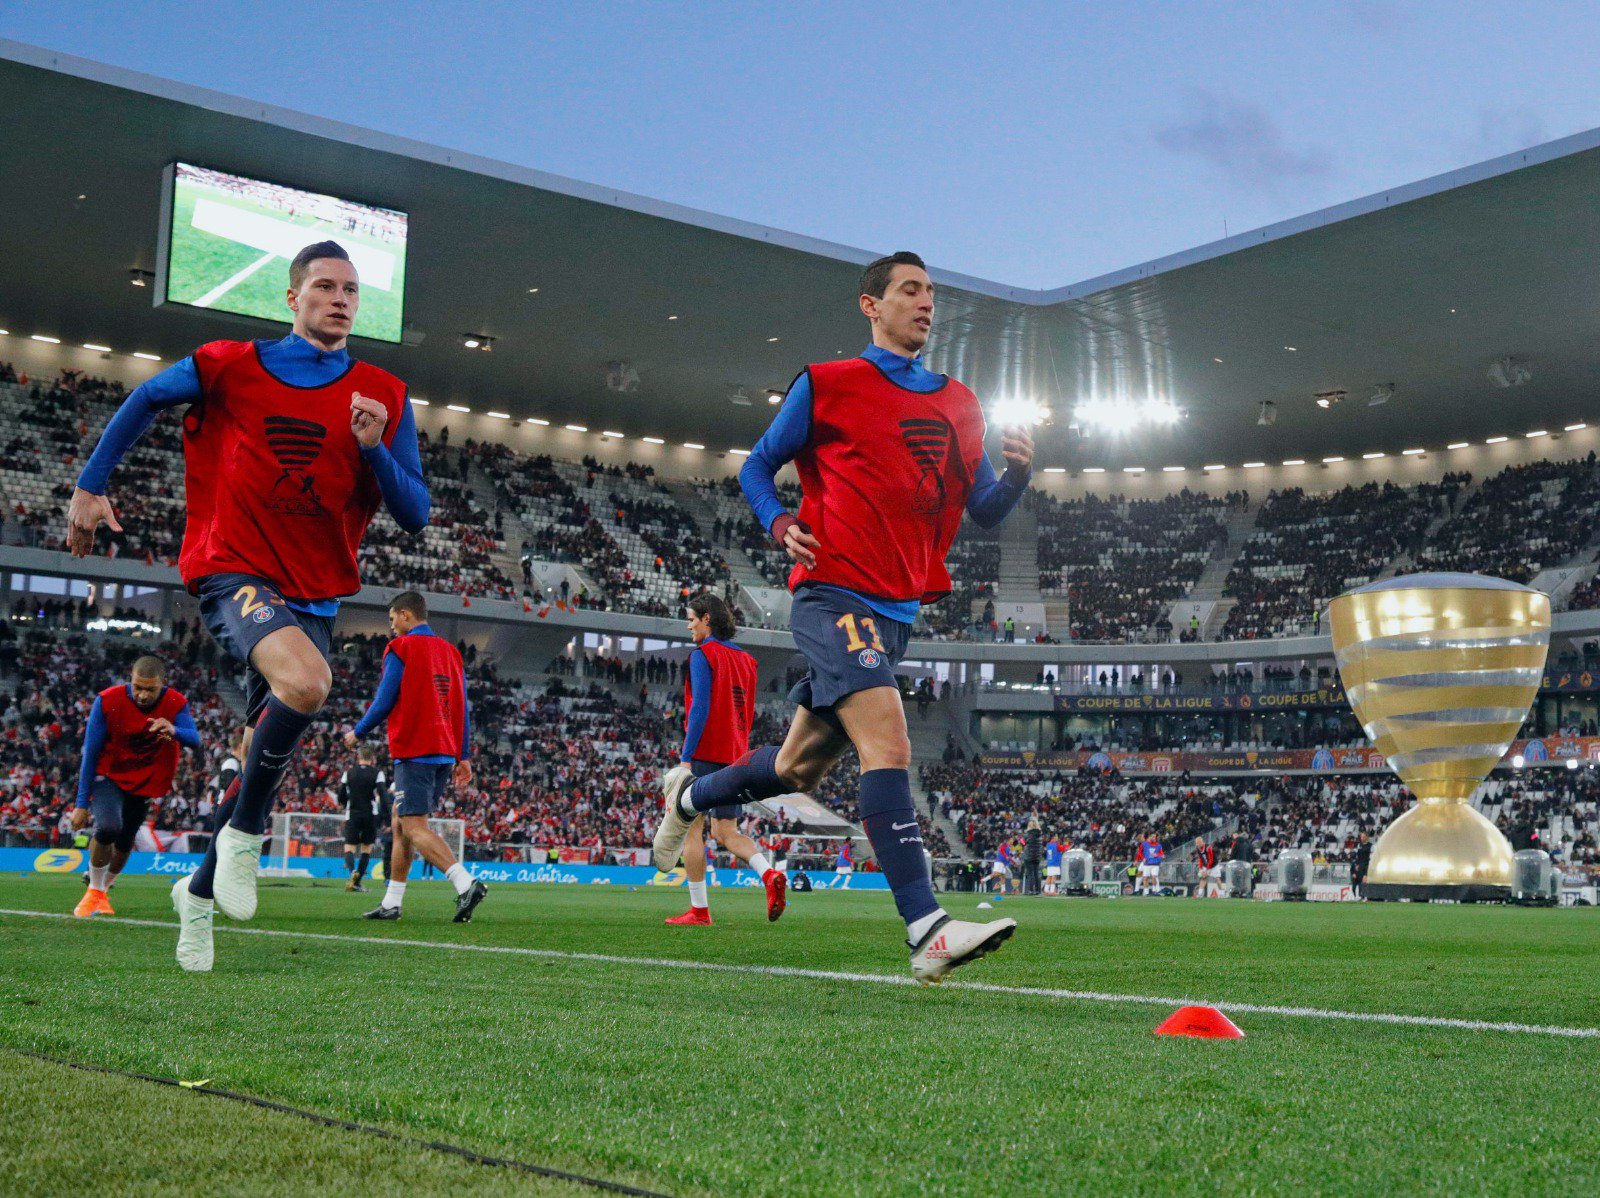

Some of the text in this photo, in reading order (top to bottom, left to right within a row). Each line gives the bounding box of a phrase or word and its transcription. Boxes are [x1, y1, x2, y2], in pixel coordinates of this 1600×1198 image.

[835, 612, 886, 653] 11
[1077, 698, 1120, 708] COUPE
[1124, 698, 1140, 707] DE
[1155, 697, 1171, 707] LA
[1258, 692, 1345, 705] COUPE DE LA
[982, 756, 1009, 764] COUPE
[1010, 757, 1021, 765] DE
[1037, 757, 1048, 765] LA
[1208, 758, 1234, 766] COUPE
[1234, 757, 1245, 765] DE
[1259, 757, 1269, 765] LA
[146, 852, 200, 873] tous
[469, 861, 513, 881] tous
[1095, 885, 1120, 896] sport
